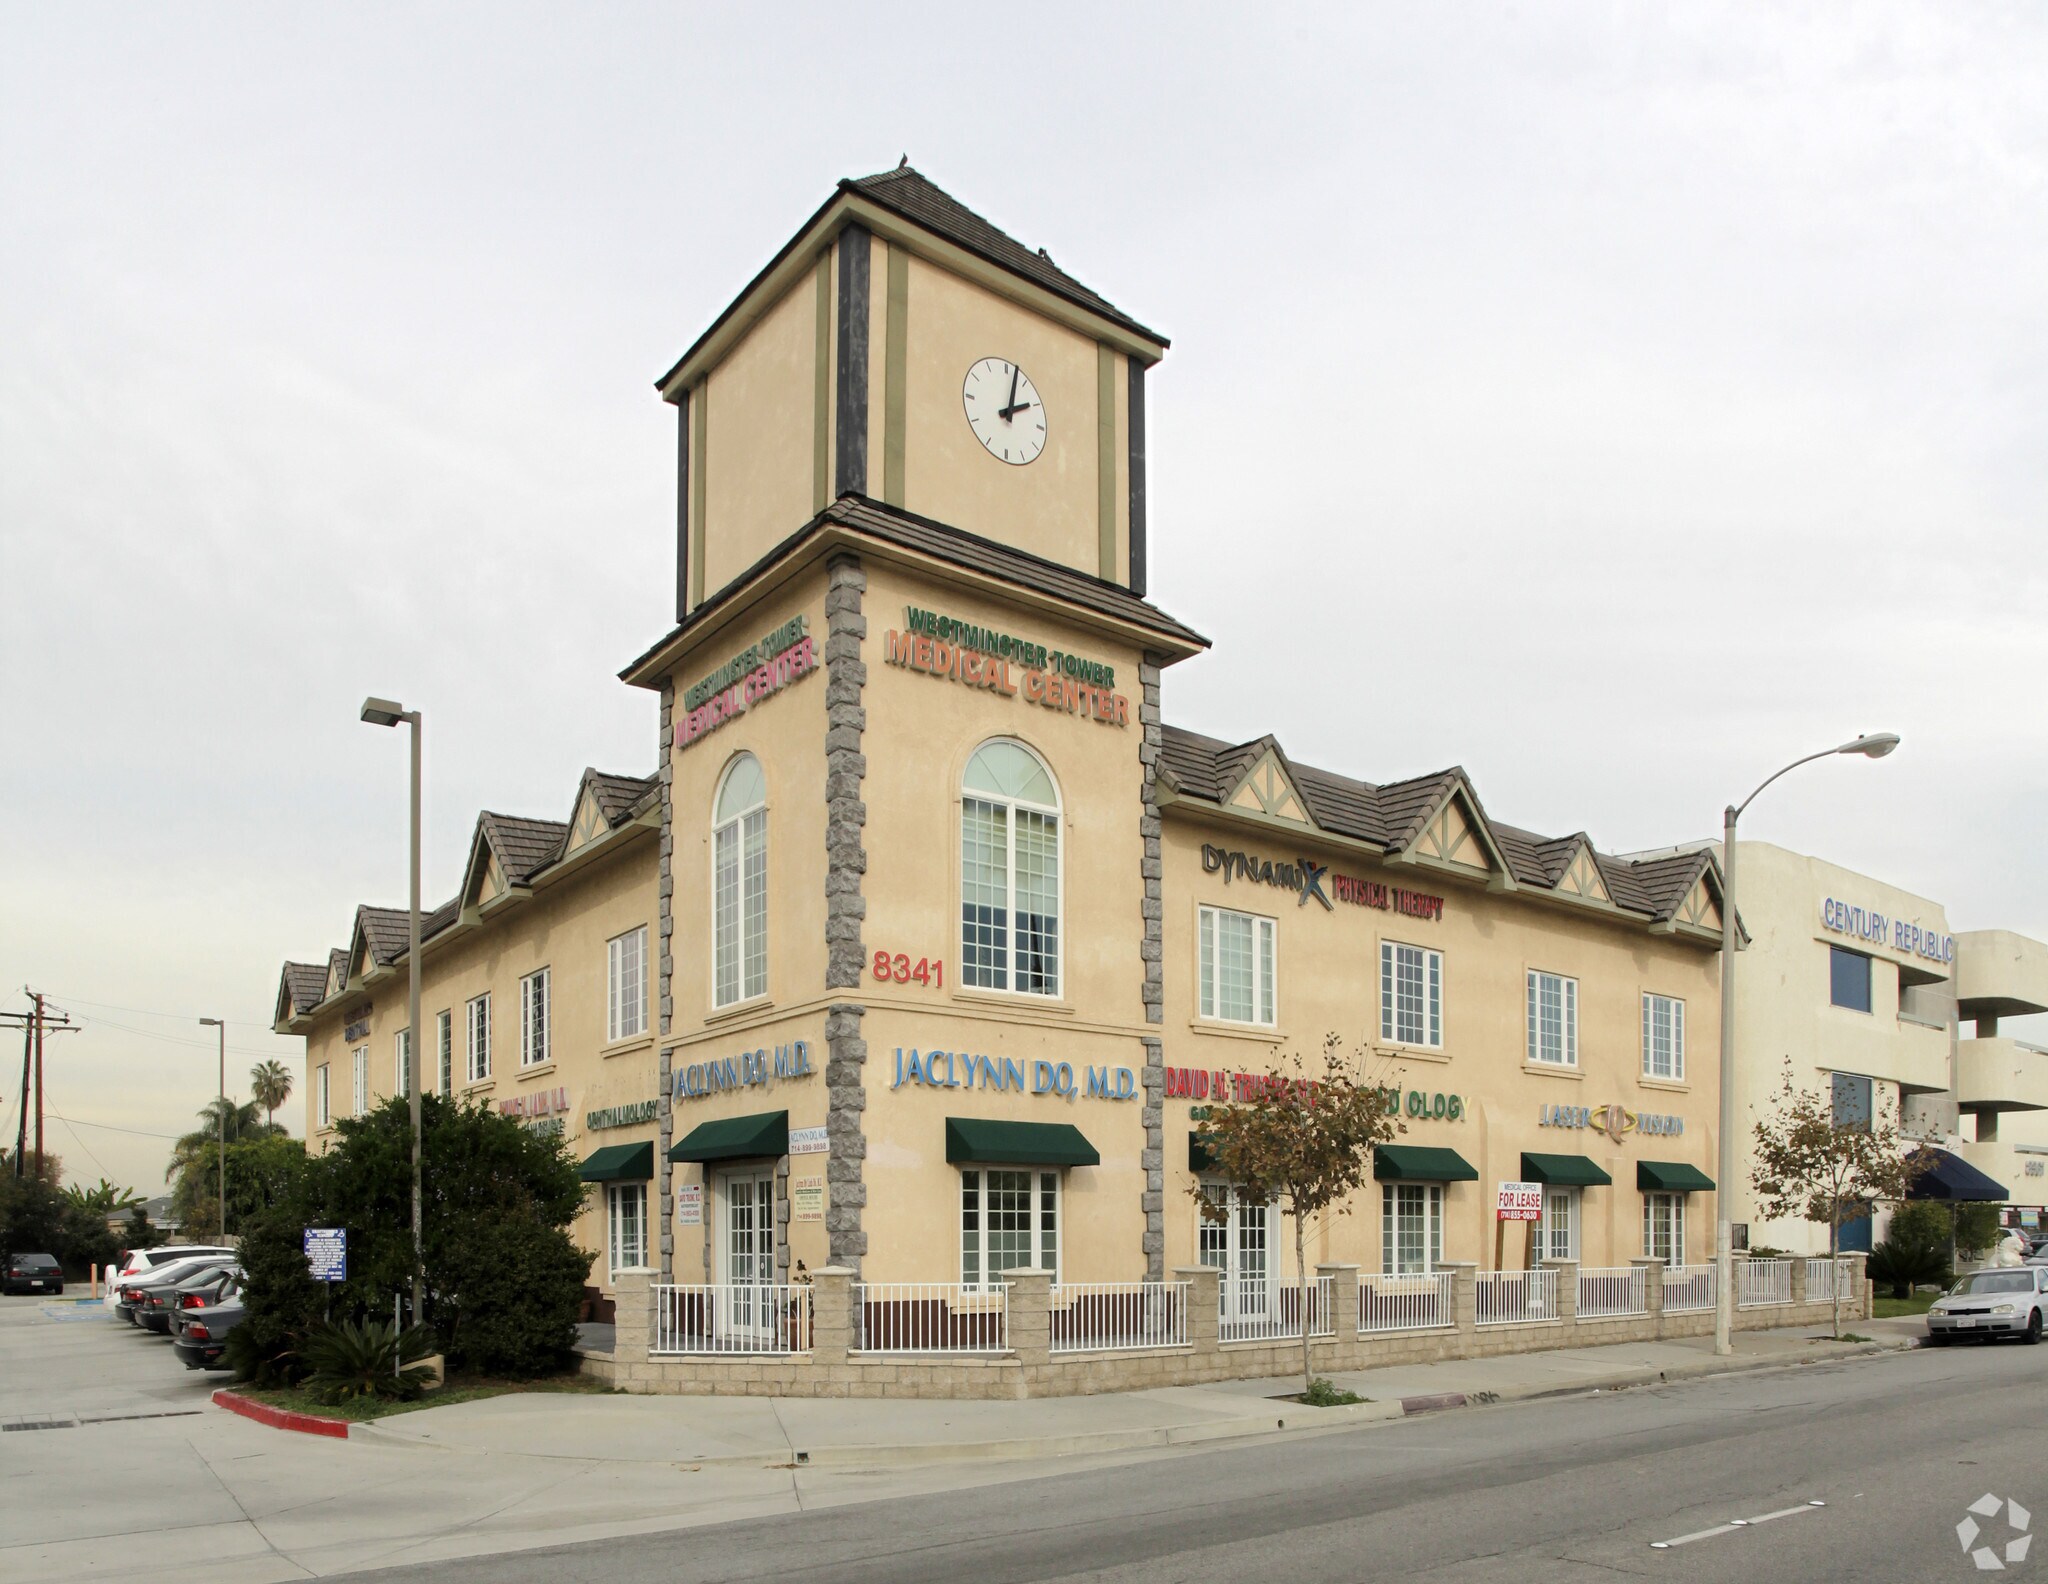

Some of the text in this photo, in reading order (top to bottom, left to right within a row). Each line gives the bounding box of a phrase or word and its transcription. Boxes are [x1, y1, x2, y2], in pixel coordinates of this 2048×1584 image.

[684, 614, 805, 712] WESTMINSTER TOWER
[906, 605, 1115, 688] WESTMINSTER TOWER
[677, 637, 815, 749] MEDICAL CENTER
[887, 629, 1130, 725] MEDICAL CENTER
[1333, 874, 1390, 910] PHYSICAL
[1392, 888, 1444, 921] THERAPY
[1824, 897, 1953, 962] CENTURY REPUBLIC
[872, 950, 943, 989] 8341
[672, 1040, 811, 1105] JACLYNN DO, M.D.
[893, 1047, 1139, 1099] JACLYNN DO, M.D.
[1165, 1066, 1209, 1098] DAVID
[1212, 1071, 1229, 1100] M.
[586, 1099, 659, 1131] OPHTHALMOLOGY
[1540, 1104, 1589, 1127] LASER
[1637, 1113, 1685, 1135] VISION
[1499, 1192, 1540, 1207] FOR LEASE
